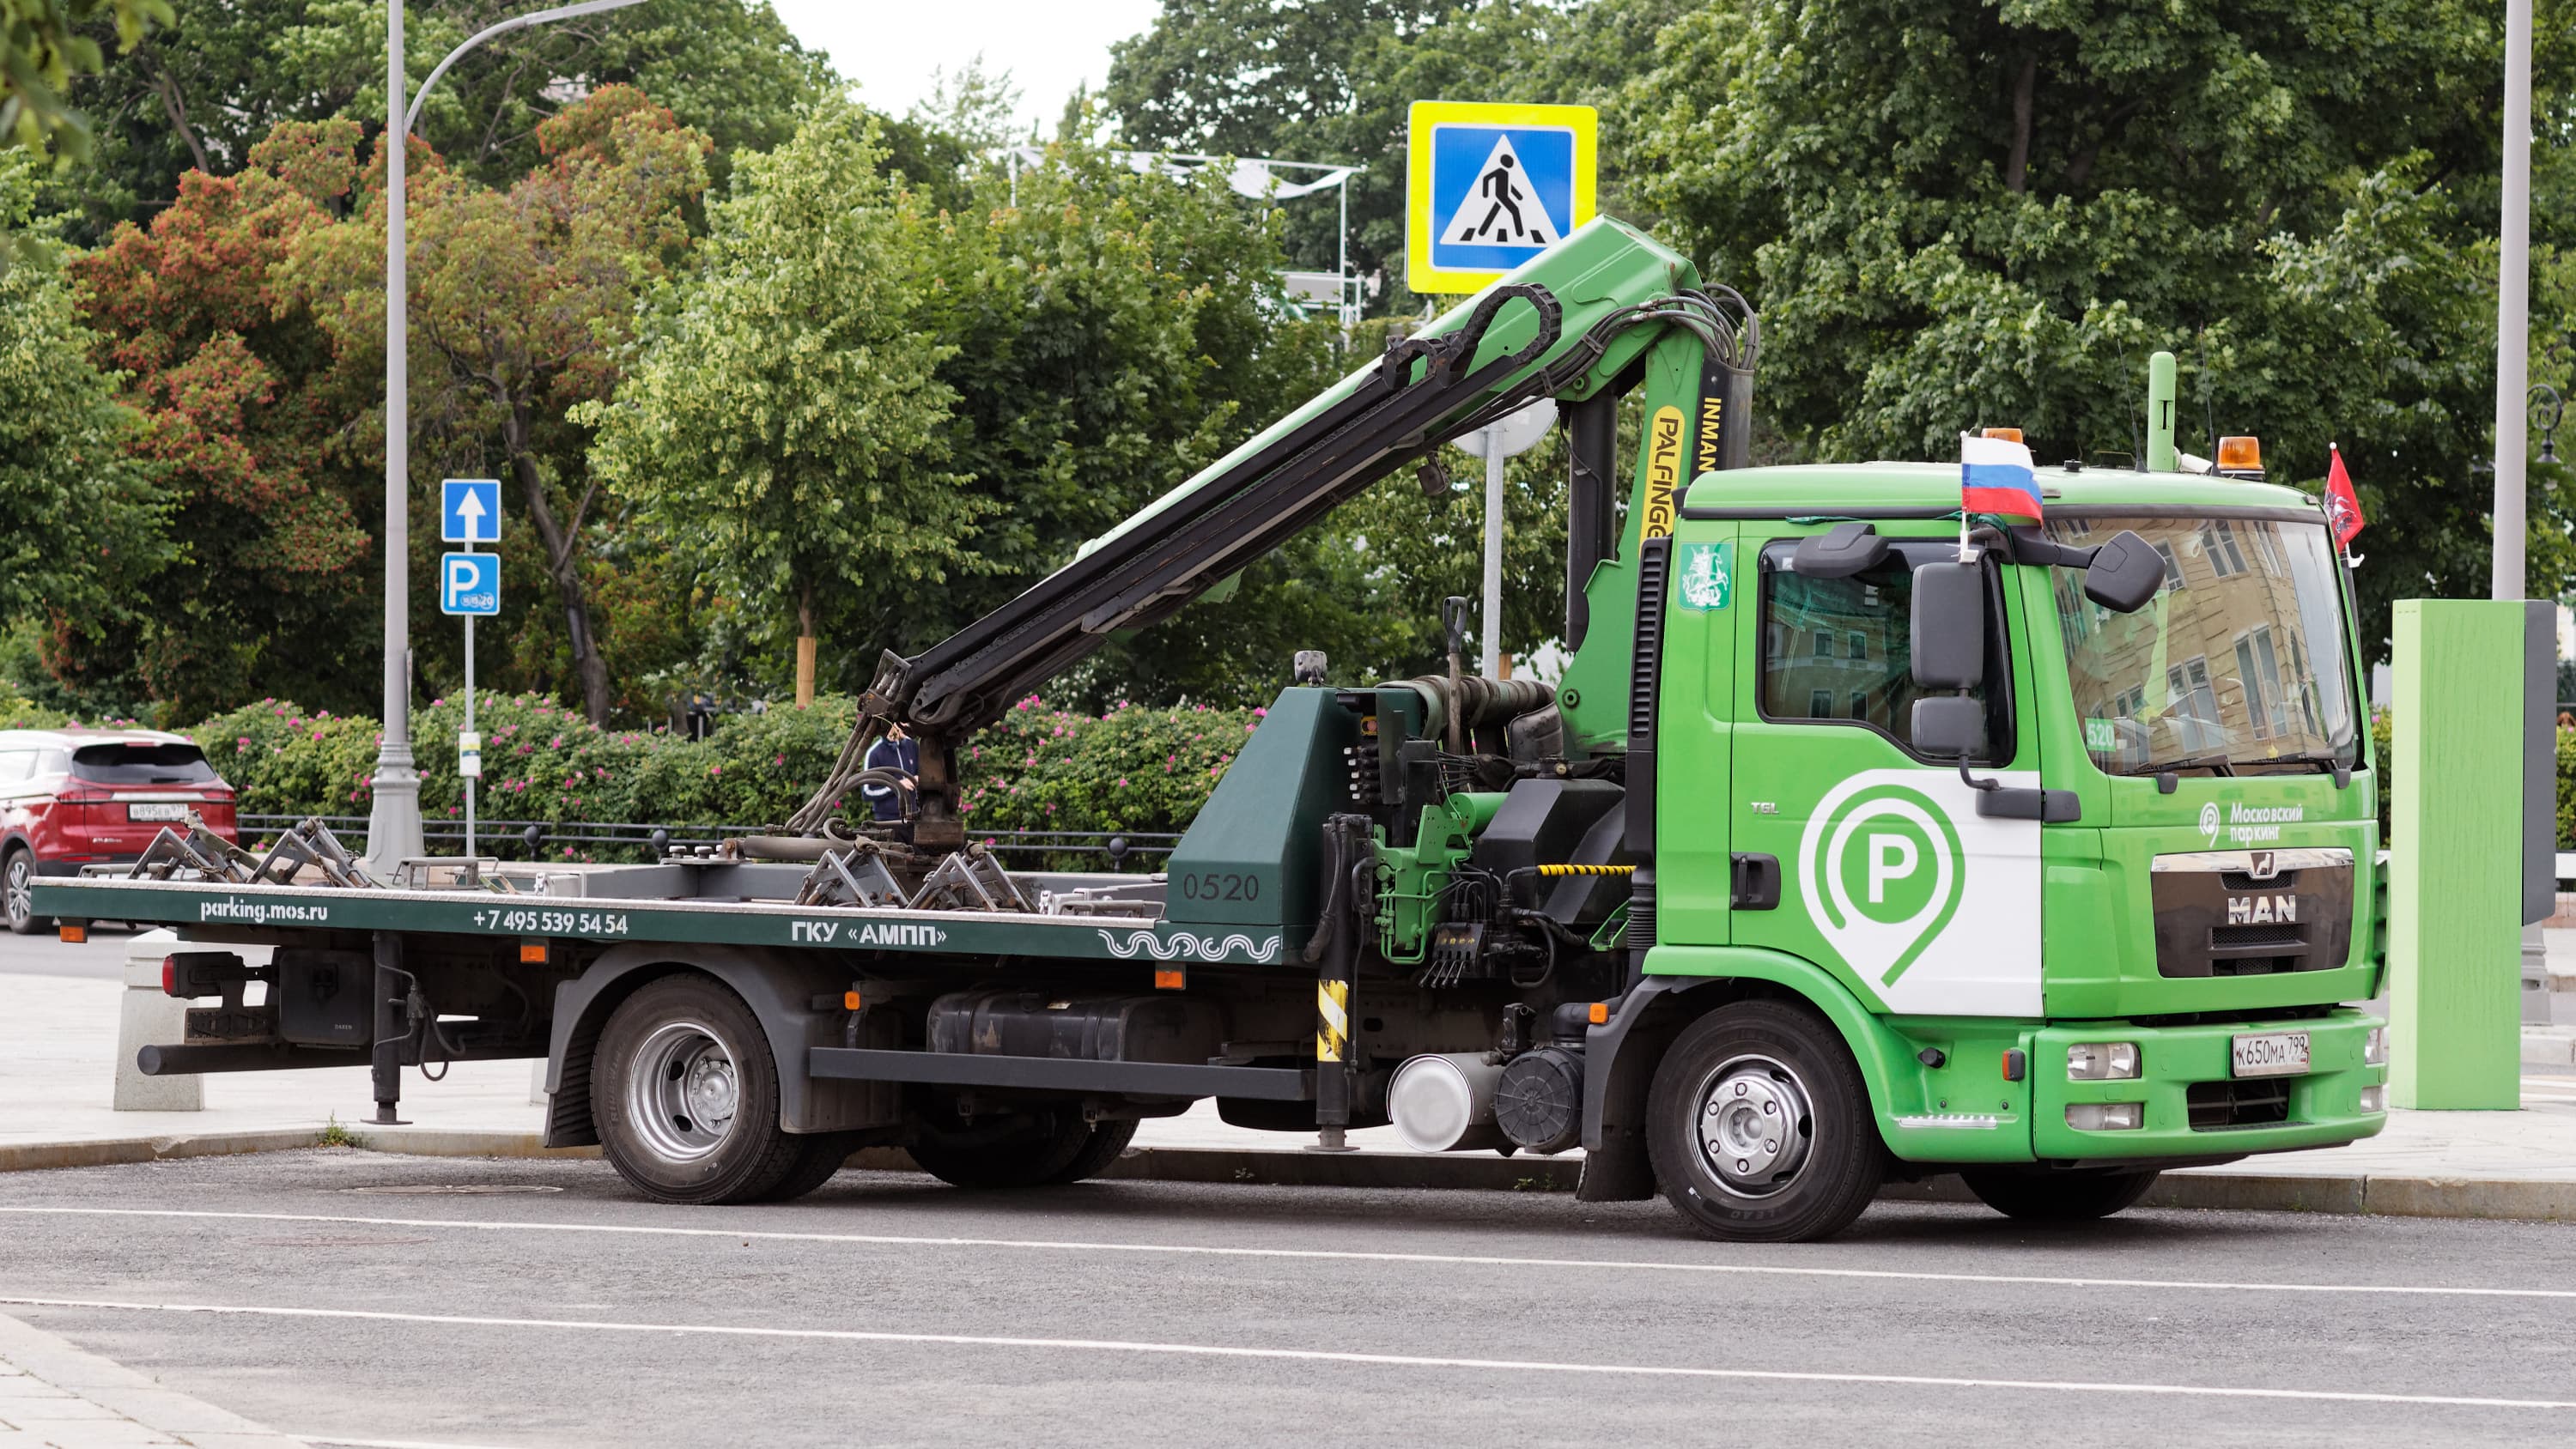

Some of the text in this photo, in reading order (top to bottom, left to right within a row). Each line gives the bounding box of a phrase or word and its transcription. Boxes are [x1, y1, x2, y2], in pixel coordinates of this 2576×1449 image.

[1698, 397, 1722, 471] INMAN
[449, 561, 480, 608] P
[480, 595, 494, 606] 20
[2087, 723, 2115, 746] 520
[1752, 802, 1780, 814] TGL
[2231, 803, 2303, 823] Московский
[2230, 826, 2280, 848] паркинг
[1868, 834, 1918, 903] P
[1183, 873, 1259, 901] 0520
[201, 895, 327, 923] parking.mos.ru
[2227, 895, 2296, 925] MAN
[503, 910, 538, 931] 495
[541, 912, 574, 933] 539
[579, 913, 601, 934] 54
[605, 914, 629, 935] 54
[792, 921, 946, 946] ГКУ «АМПП»
[2239, 1036, 2306, 1065] К650МА 799
